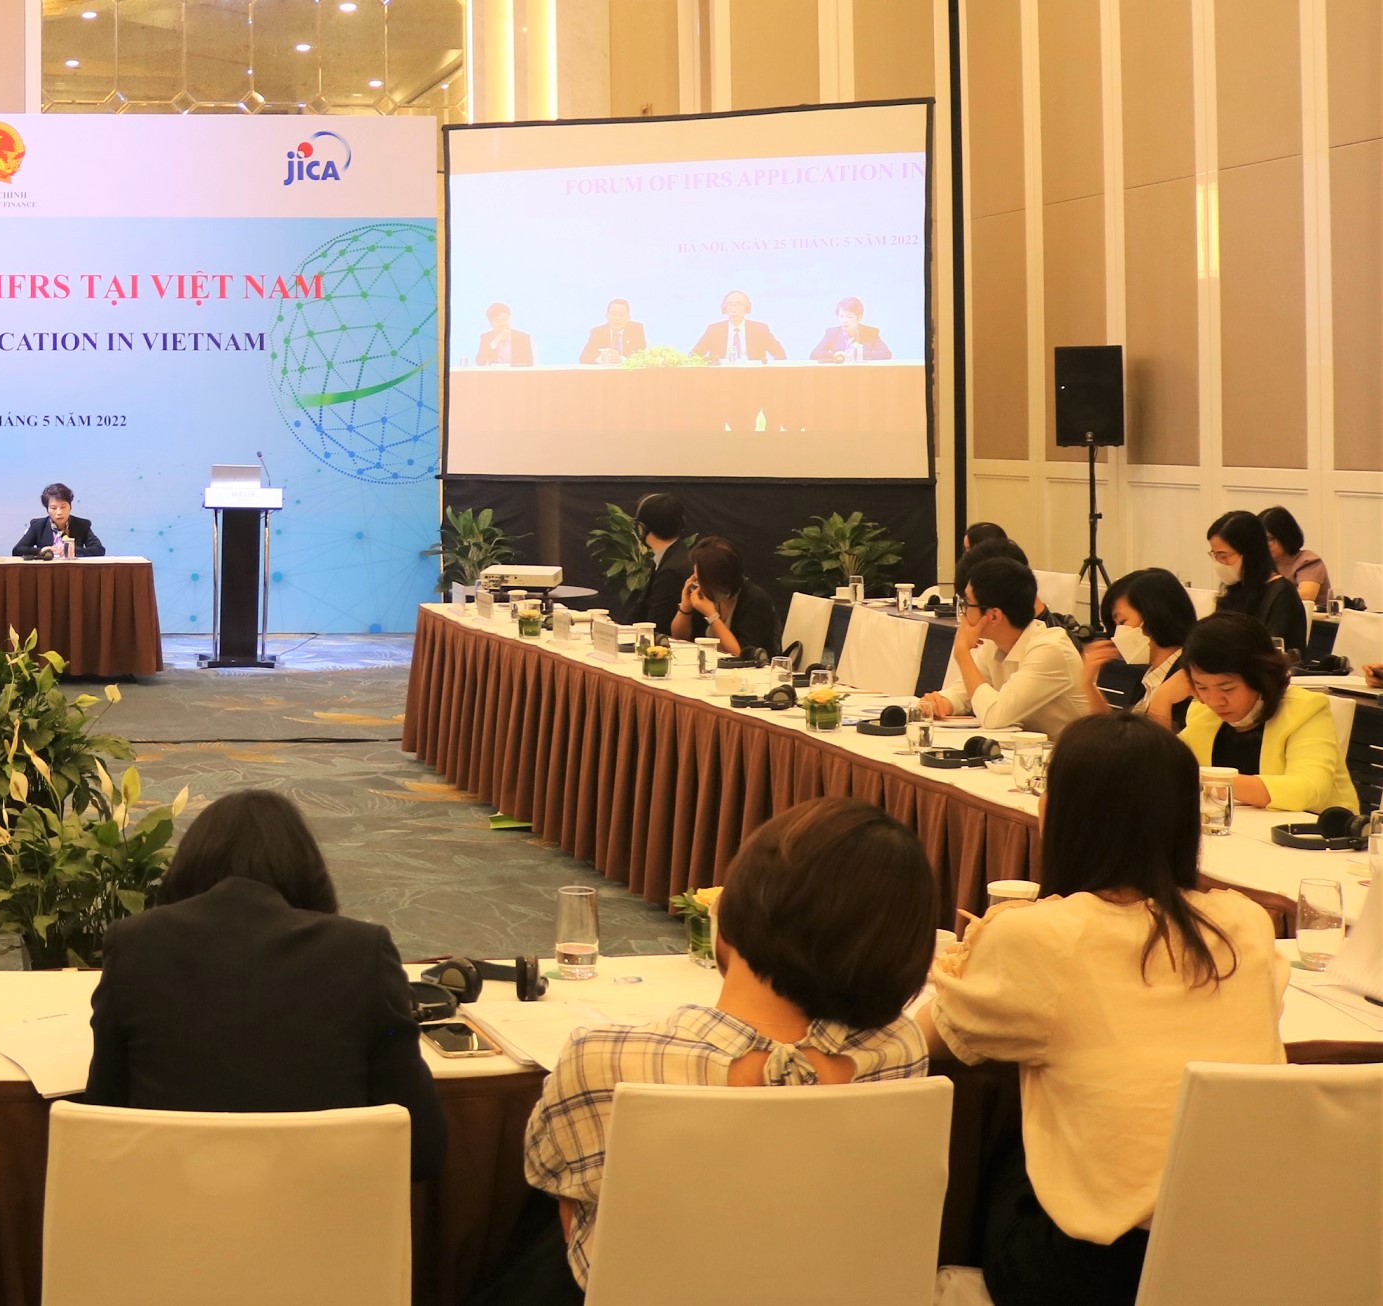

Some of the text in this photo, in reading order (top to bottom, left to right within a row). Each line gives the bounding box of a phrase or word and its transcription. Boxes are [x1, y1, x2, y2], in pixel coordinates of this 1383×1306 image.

[565, 175, 643, 196] FORUM
[649, 173, 679, 192] OF
[684, 170, 733, 190] IFRS
[737, 162, 894, 188] APPLICATION
[773, 239, 787, 250] 25
[843, 236, 850, 247] 5
[890, 234, 919, 246] 2022
[80, 274, 141, 307] TẠI
[149, 270, 235, 307] VIỆT
[243, 274, 325, 300] NAM
[107, 331, 136, 351] IN
[141, 331, 266, 352] VIETNAM
[42, 415, 51, 427] 5
[55, 412, 92, 427] NĂM
[96, 415, 127, 427] 2022
